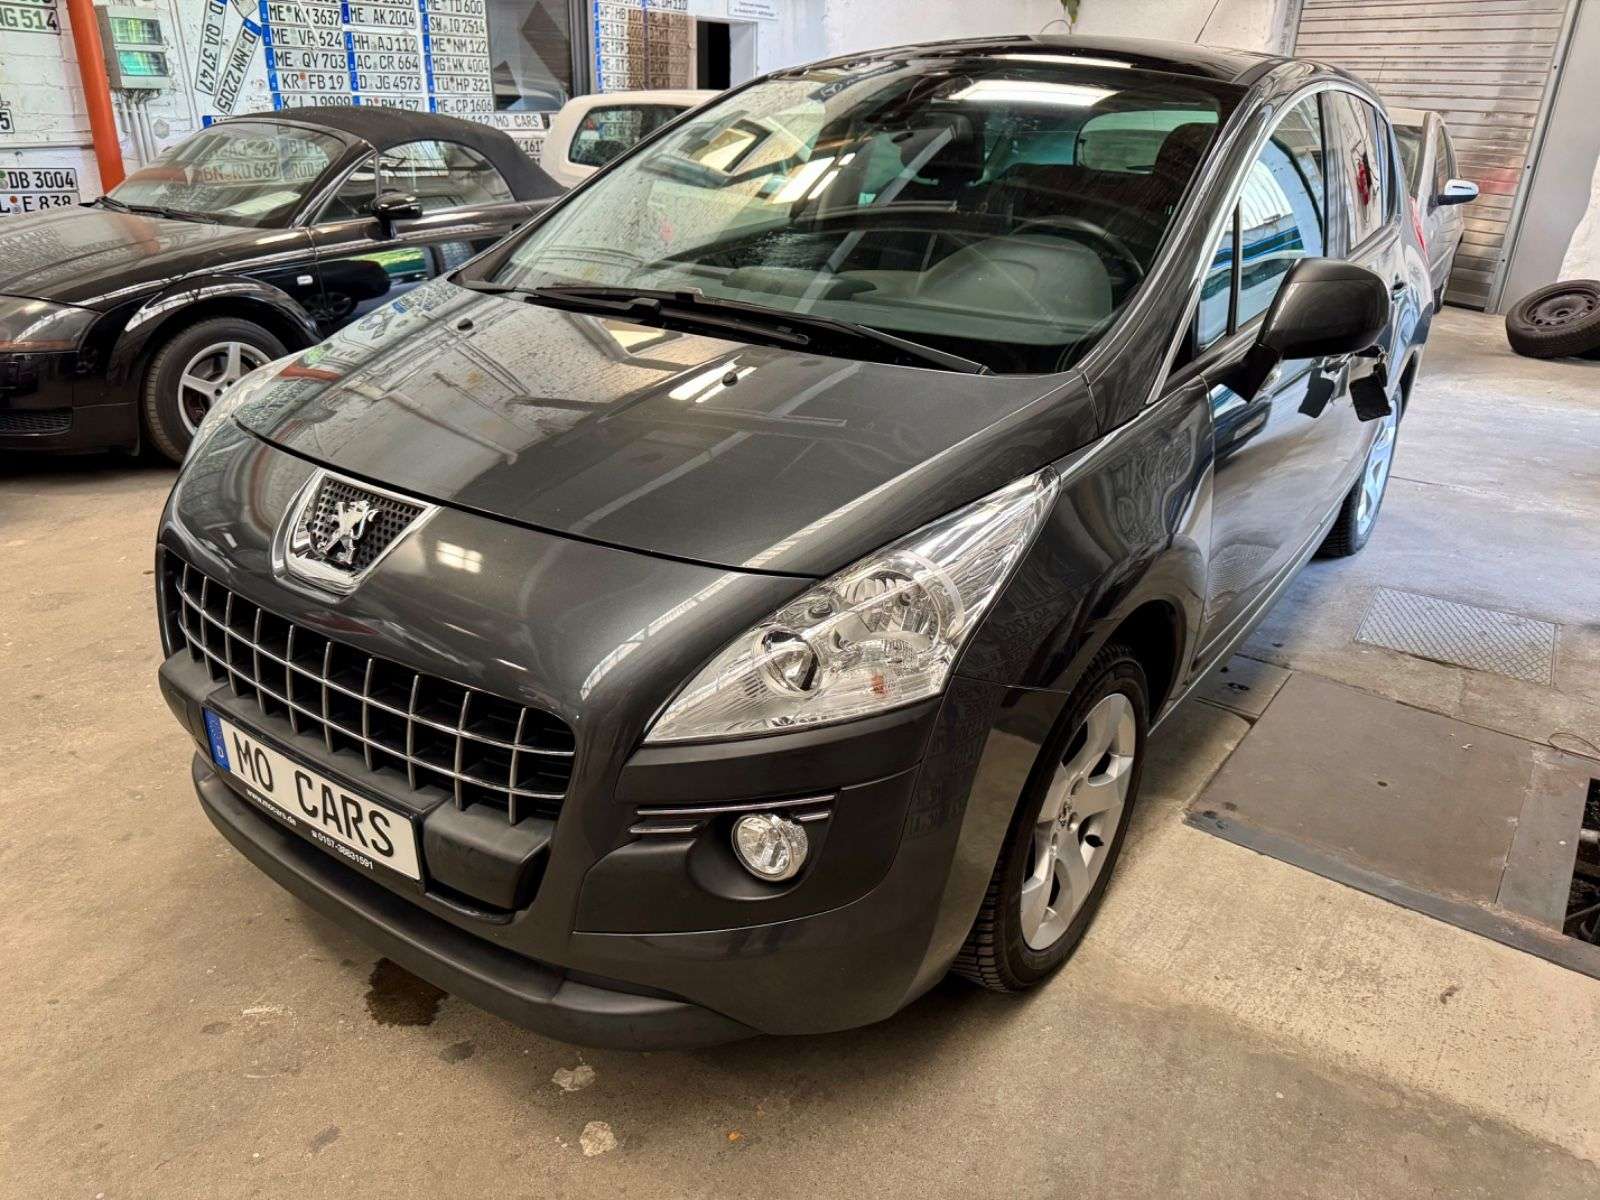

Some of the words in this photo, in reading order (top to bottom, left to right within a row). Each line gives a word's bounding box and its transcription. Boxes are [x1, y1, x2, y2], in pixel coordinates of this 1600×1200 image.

[210, 1, 224, 15] D
[269, 4, 285, 21] ME
[312, 8, 340, 25] 3637
[0, 8, 18, 27] G
[20, 10, 56, 30] 514
[350, 8, 364, 22] ME
[374, 9, 386, 24] AK
[389, 10, 414, 26] 2014
[204, 24, 220, 46] QA
[242, 28, 256, 44] D
[272, 28, 290, 44] ME
[320, 32, 342, 46] 624
[353, 34, 370, 50] HH
[378, 36, 393, 51] AJ
[395, 38, 416, 52] 112
[432, 38, 446, 52] ME
[231, 48, 250, 74] MM
[276, 51, 293, 66] ME
[303, 52, 318, 68] QY
[322, 54, 346, 68] 703
[358, 55, 372, 69] AC
[380, 56, 396, 70] CR
[398, 56, 418, 70] 664
[200, 48, 218, 92] 3747
[282, 73, 300, 89] KR
[308, 74, 326, 90] FB
[329, 75, 344, 90] 19
[360, 75, 367, 89] D
[375, 75, 390, 89] JG
[393, 76, 420, 90] 4573
[472, 78, 490, 92] 321
[218, 70, 242, 112] 2205
[494, 116, 510, 128] MO
[514, 116, 538, 128] CARS
[8, 172, 30, 188] DB
[33, 171, 74, 188] 3004
[22, 196, 35, 212] E
[232, 731, 274, 792] MO
[294, 770, 394, 858] CARS
